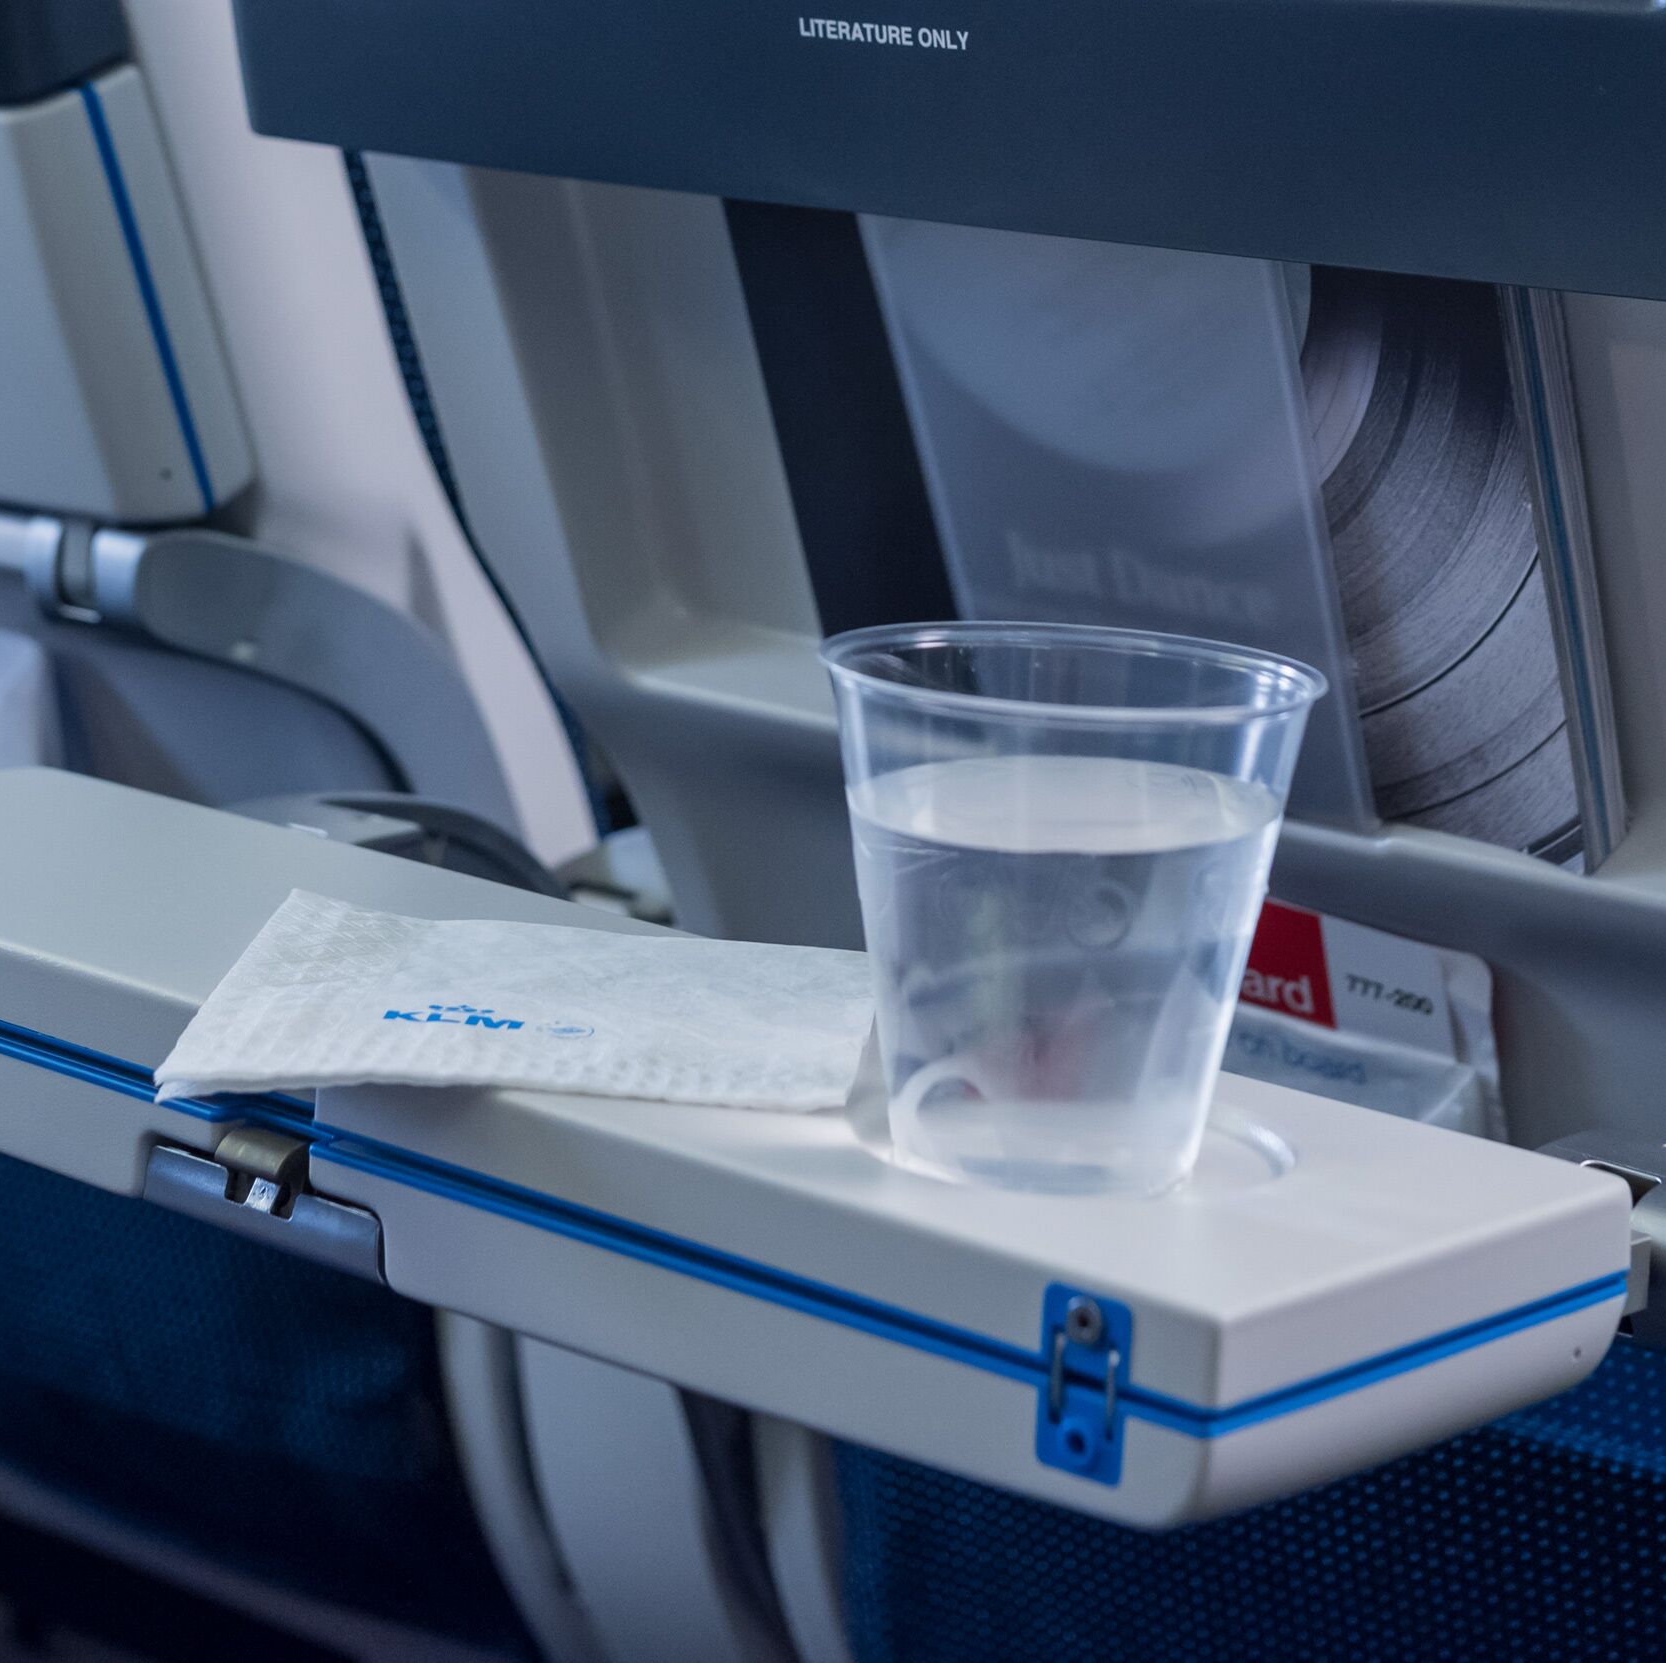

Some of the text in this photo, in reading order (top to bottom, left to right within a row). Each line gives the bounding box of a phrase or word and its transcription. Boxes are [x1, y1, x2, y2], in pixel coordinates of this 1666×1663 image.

[799, 17, 969, 51] LITERATURE ONLY
[383, 1009, 525, 1031] KLM
